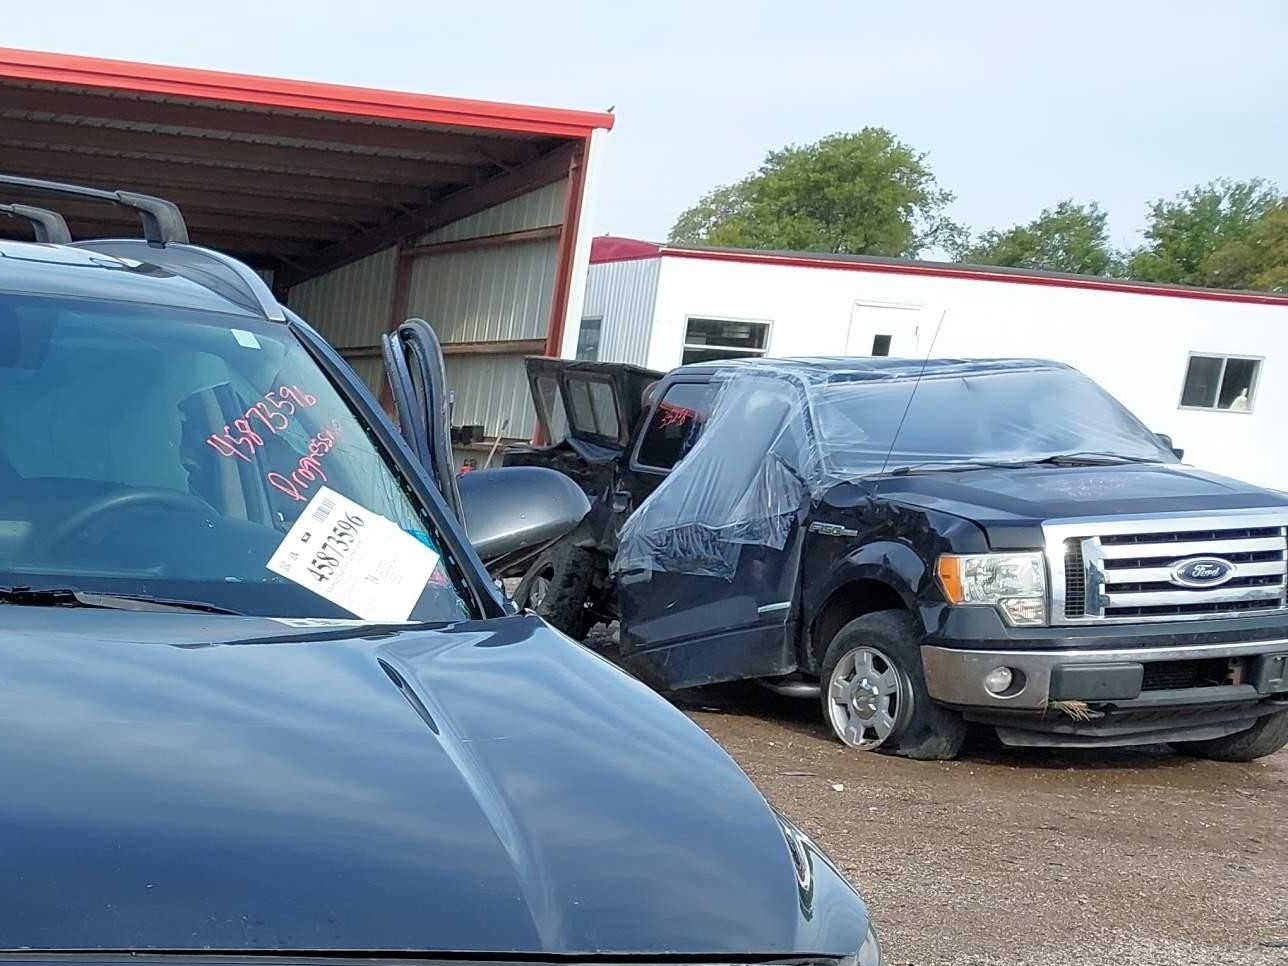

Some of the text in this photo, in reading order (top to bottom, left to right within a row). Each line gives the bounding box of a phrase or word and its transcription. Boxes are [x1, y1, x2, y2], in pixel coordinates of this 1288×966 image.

[206, 386, 317, 463] 45873596
[306, 511, 365, 583] 45873596
[1192, 564, 1220, 578] Ford
